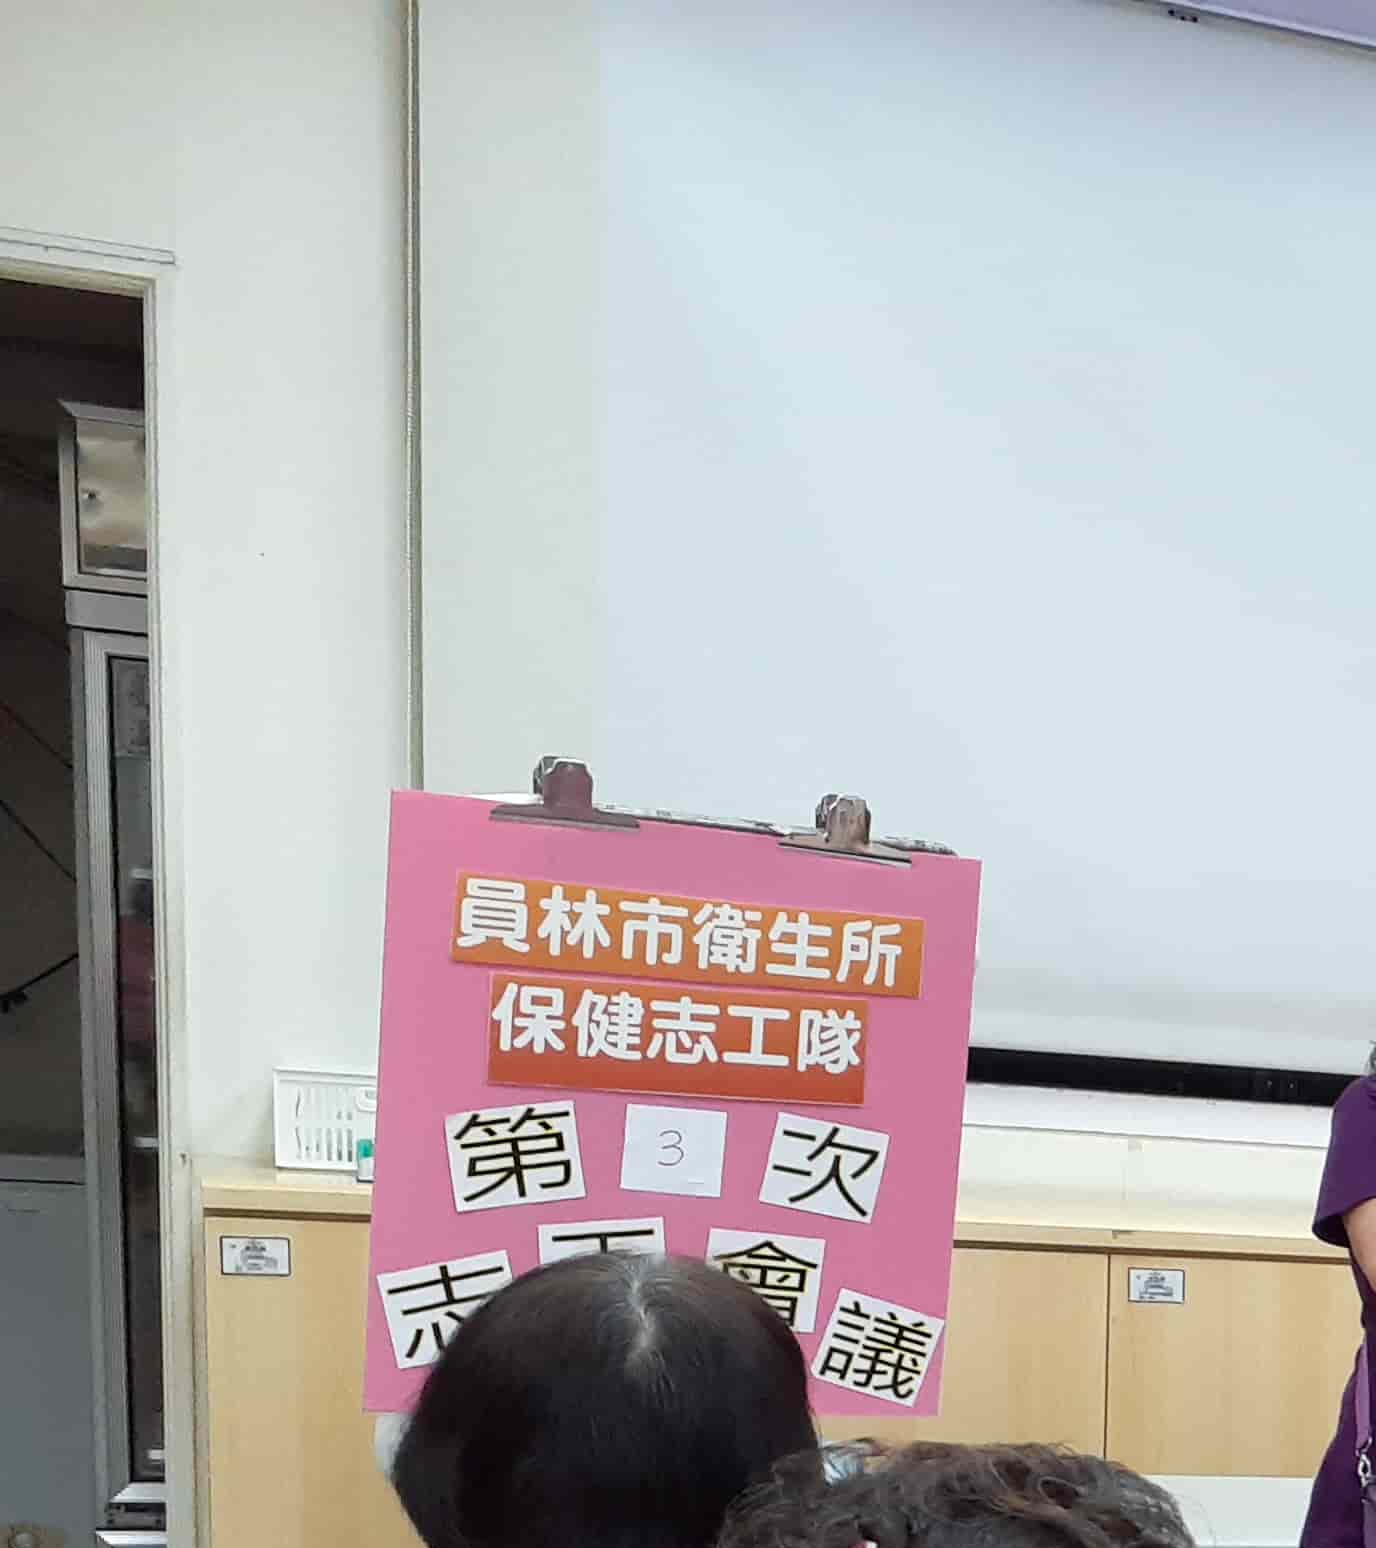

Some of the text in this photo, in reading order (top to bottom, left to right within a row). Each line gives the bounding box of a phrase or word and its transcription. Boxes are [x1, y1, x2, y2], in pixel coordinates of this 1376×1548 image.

[456, 877, 902, 988] 員林市衛生所
[491, 982, 863, 1074] 保健志工隊
